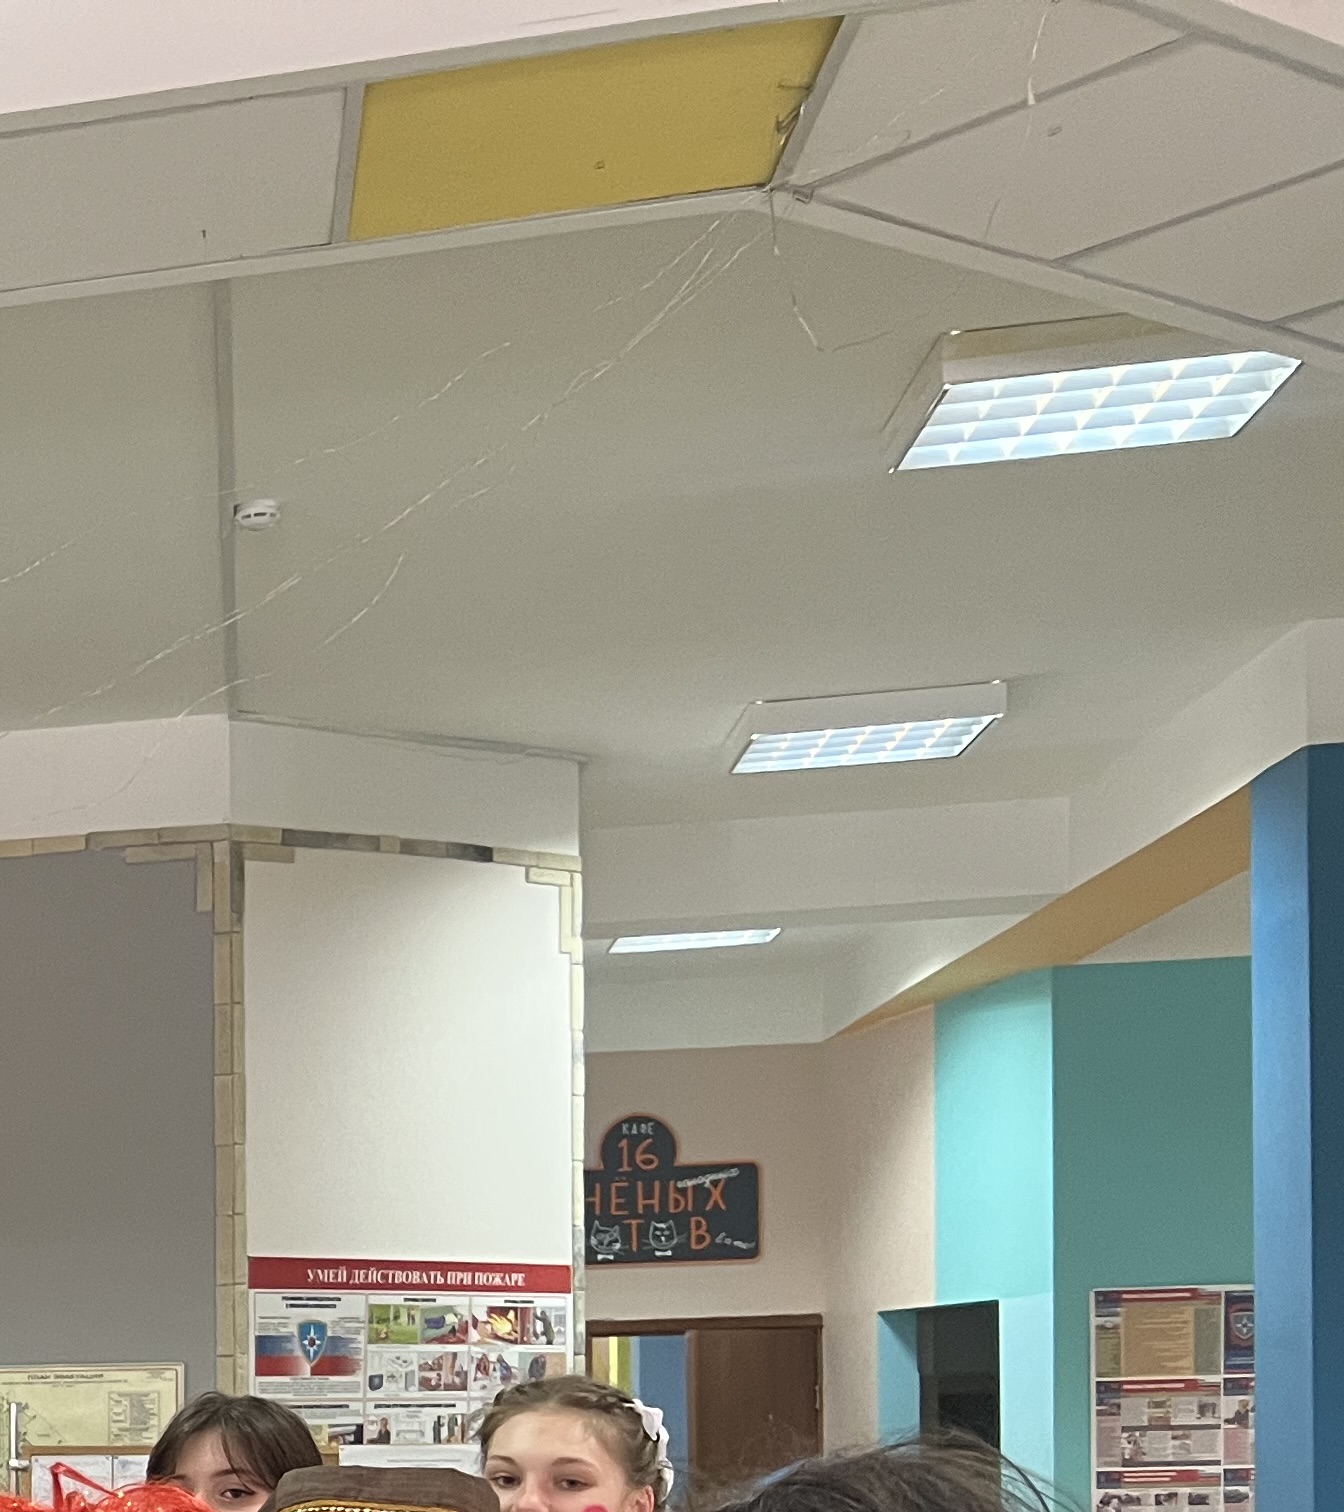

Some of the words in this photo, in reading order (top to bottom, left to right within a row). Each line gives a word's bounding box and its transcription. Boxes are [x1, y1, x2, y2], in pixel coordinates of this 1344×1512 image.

[617, 1137, 660, 1172] 16
[585, 1177, 728, 1216] ЧЁНЫХ
[307, 1266, 347, 1283] УМЕЙ
[349, 1267, 445, 1285] ДЕЙСТВОВАТЬ
[446, 1271, 472, 1285] ПРИ
[474, 1273, 526, 1287] ПОЖАРЕ
